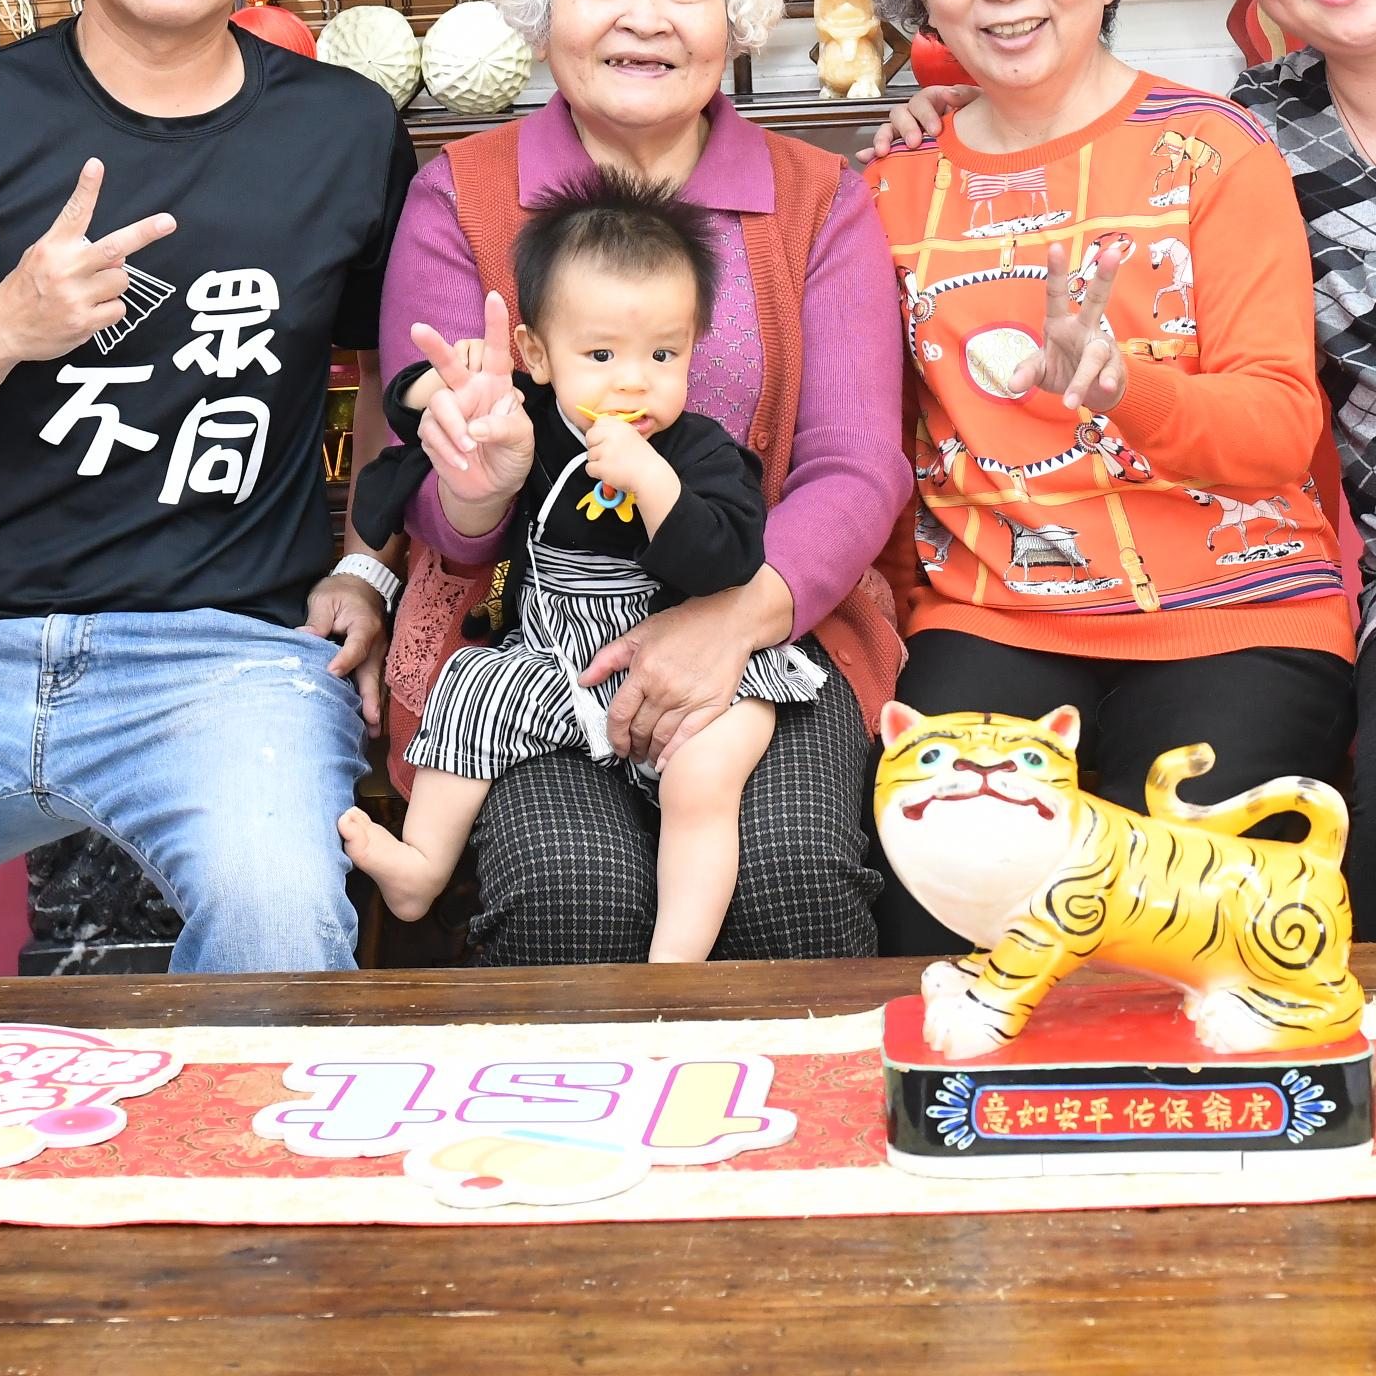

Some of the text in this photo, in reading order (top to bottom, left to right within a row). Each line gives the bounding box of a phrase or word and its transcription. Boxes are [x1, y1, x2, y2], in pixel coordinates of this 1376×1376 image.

[39, 364, 271, 505] 不同
[982, 1091, 1273, 1134] 虎爺保佑平安如意
